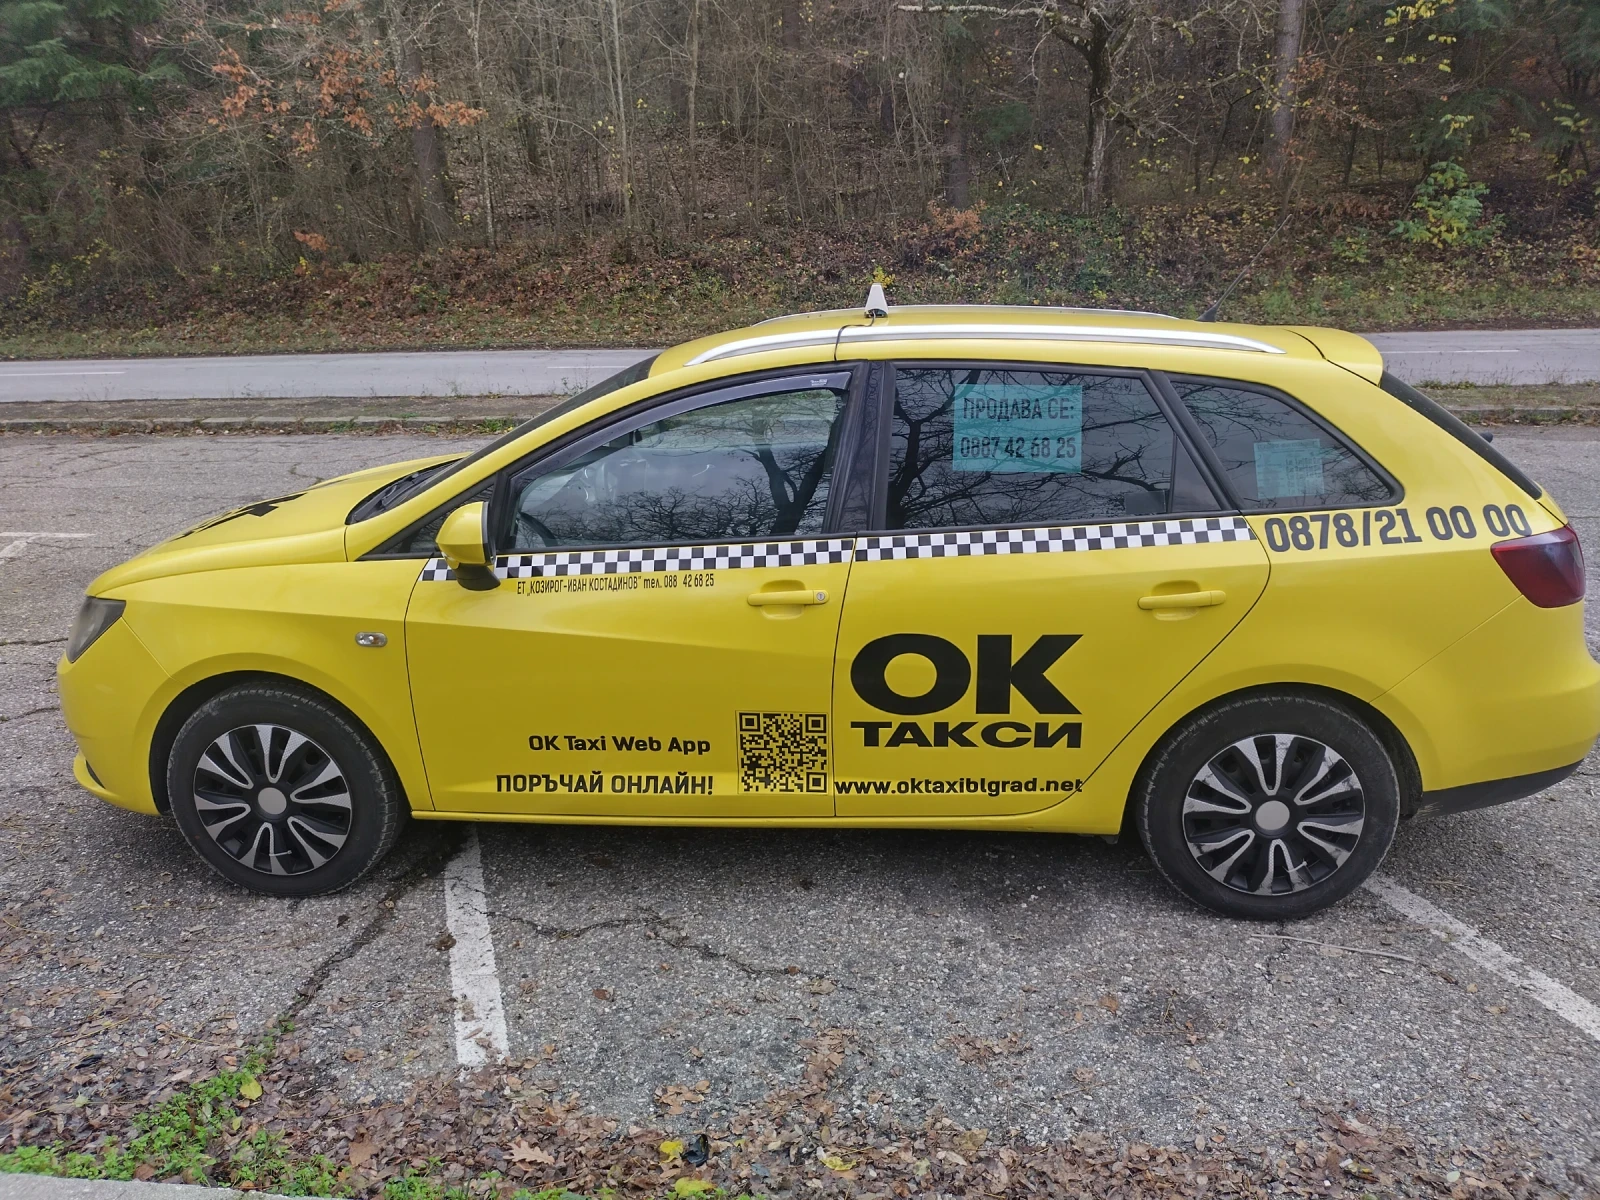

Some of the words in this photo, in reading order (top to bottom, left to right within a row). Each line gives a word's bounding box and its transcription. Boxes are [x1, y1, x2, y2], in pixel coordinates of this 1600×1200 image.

[963, 397, 1042, 422] ПРОДАВА
[1048, 398, 1074, 419] СЕ:
[960, 436, 1000, 458] 0887
[1004, 437, 1025, 458] 42
[1030, 437, 1051, 458] 68
[1056, 437, 1076, 458] 25
[1265, 508, 1422, 552] 0878/21
[1425, 505, 1477, 540] 00
[1482, 504, 1532, 537] 00
[517, 581, 526, 594] ЕТ
[683, 573, 692, 587] 42
[694, 573, 703, 587] 68
[705, 573, 714, 587] 25
[528, 735, 560, 751] OK
[564, 735, 606, 751] Taxi
[612, 736, 661, 752] Web
[668, 737, 711, 755] App
[850, 721, 1083, 749] ТАКСИ
[496, 770, 604, 793] ПОРЪЧАЙ
[611, 771, 713, 795] ОНЛАЙН!
[834, 777, 1083, 797] www.oktaxiblgrad.net
